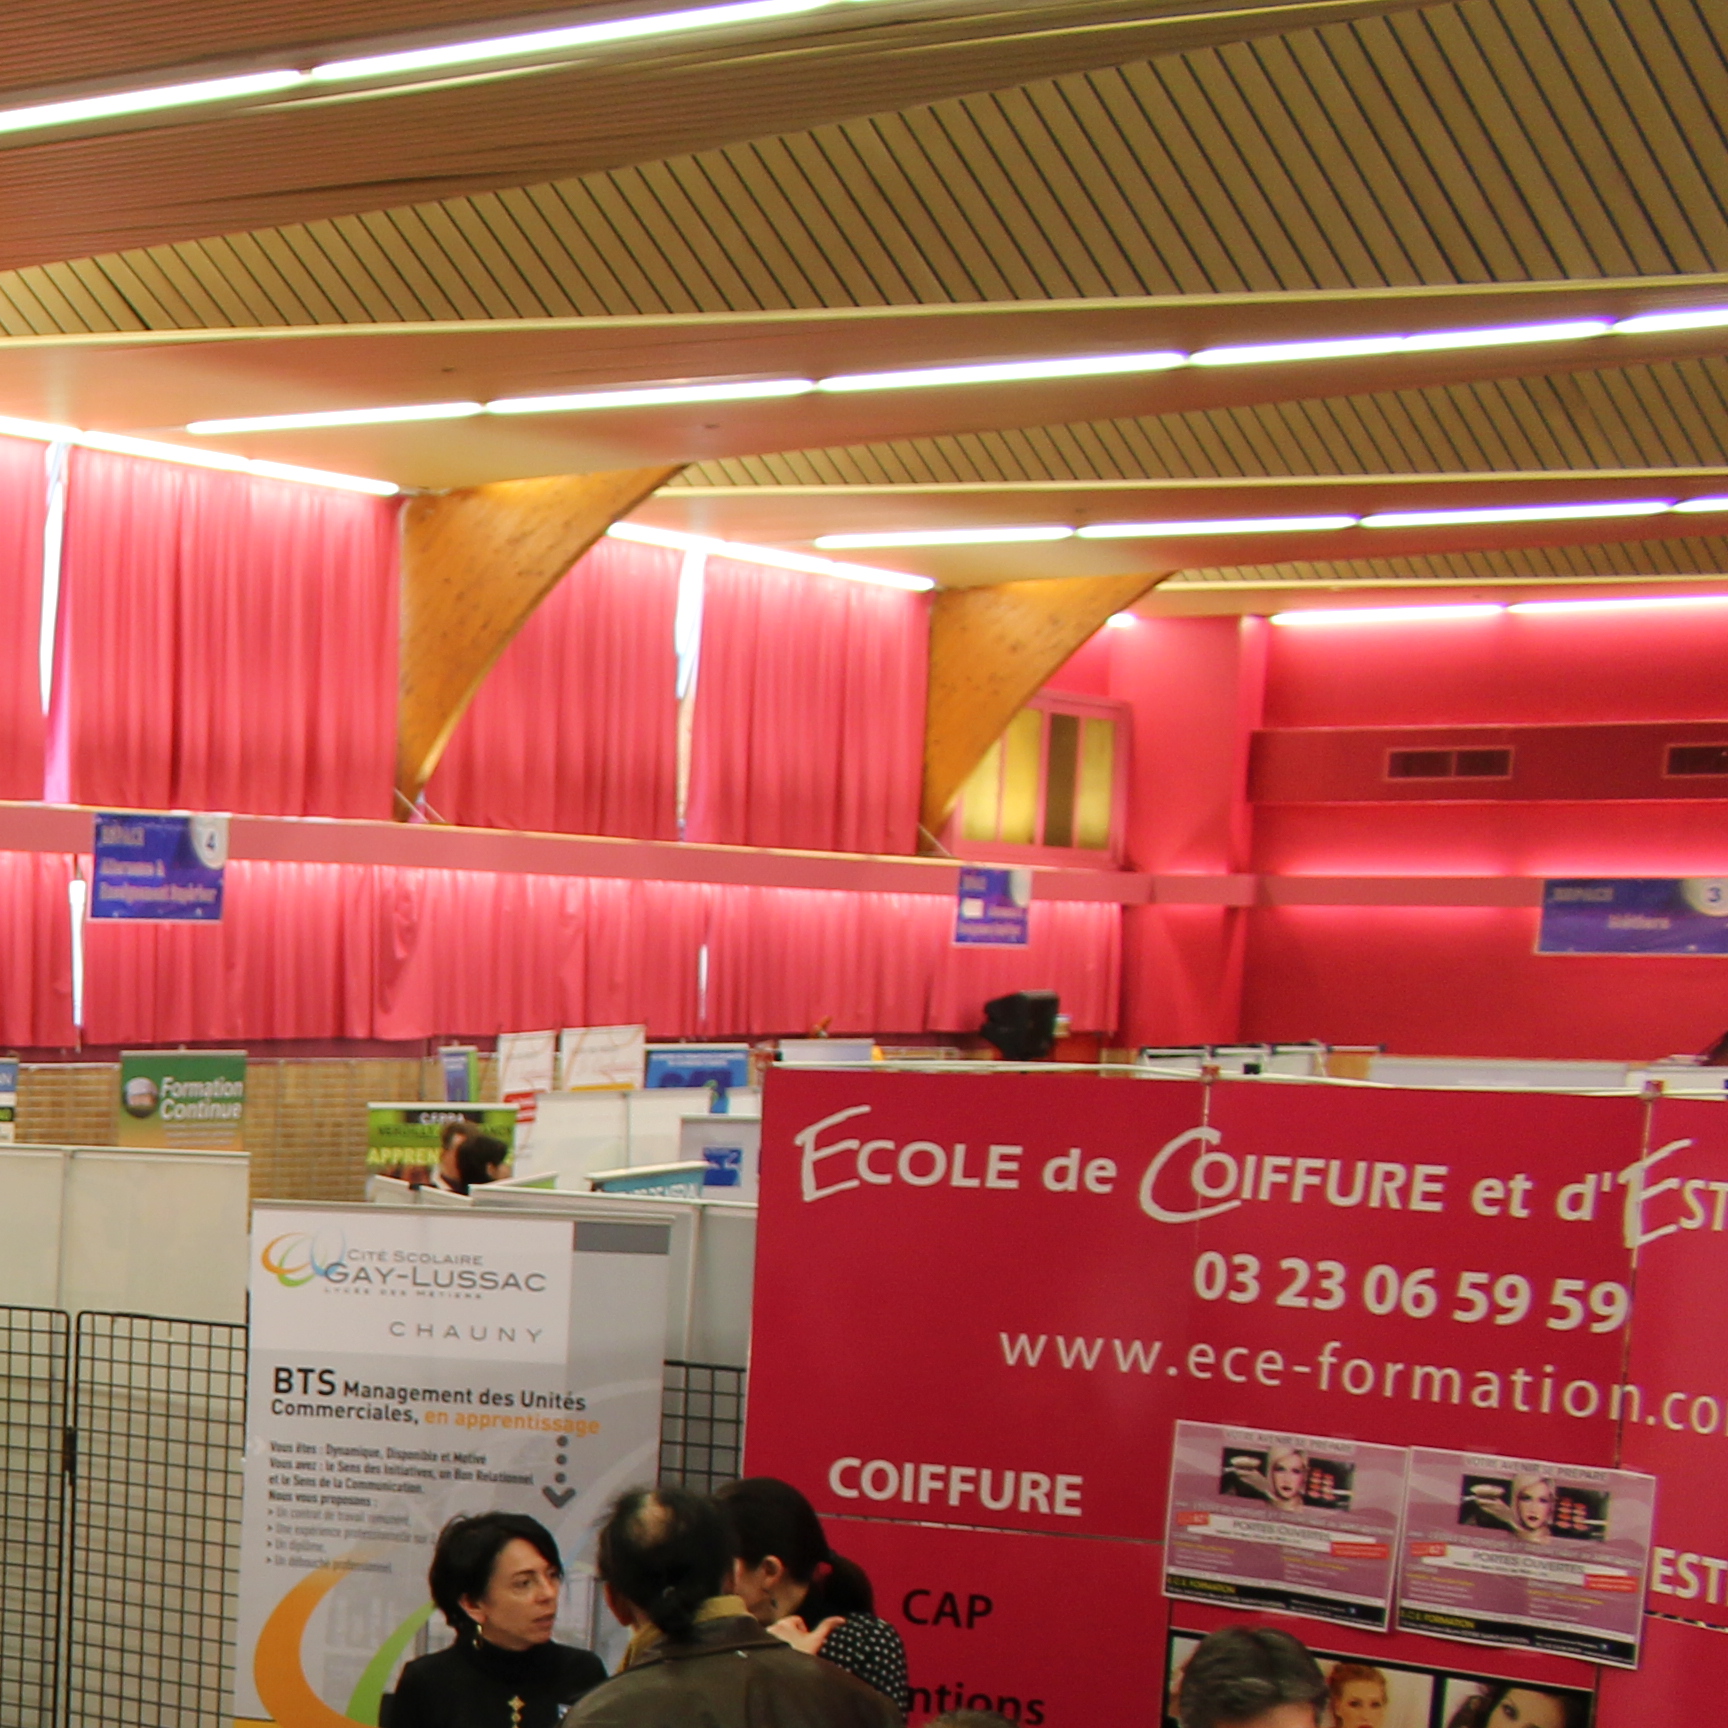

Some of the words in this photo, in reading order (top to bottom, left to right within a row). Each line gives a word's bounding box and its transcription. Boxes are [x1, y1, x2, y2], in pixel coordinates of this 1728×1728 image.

[160, 1076, 243, 1101] Formation
[160, 1098, 242, 1122] Continue
[1043, 1148, 1117, 1194] de
[1140, 1126, 1449, 1224] COIFFURE
[1470, 1173, 1532, 1218] et
[347, 1249, 388, 1262] CITÉ
[393, 1250, 483, 1266] SCOLAIRE
[324, 1262, 547, 1292] GAY-LUSSAC
[1195, 1250, 1260, 1303] 03
[1275, 1258, 1345, 1309] 23
[1363, 1263, 1438, 1318] 06
[1453, 1271, 1531, 1324] 59
[1547, 1280, 1627, 1334] 59
[389, 1321, 543, 1343] CHAUNY
[273, 1367, 336, 1396] BTS
[344, 1380, 473, 1405] Management
[480, 1387, 514, 1407] des
[521, 1390, 586, 1412] Unités
[271, 1399, 420, 1426] Commerciales,
[424, 1410, 448, 1425] en
[454, 1408, 600, 1436] apprentissage
[270, 1441, 293, 1453] Vous
[386, 1446, 438, 1463] Disponible
[270, 1459, 293, 1470] Vous
[828, 1456, 1084, 1518] COIFFURE
[1473, 1550, 1520, 1567] PORTES
[902, 1588, 993, 1630] CAP
